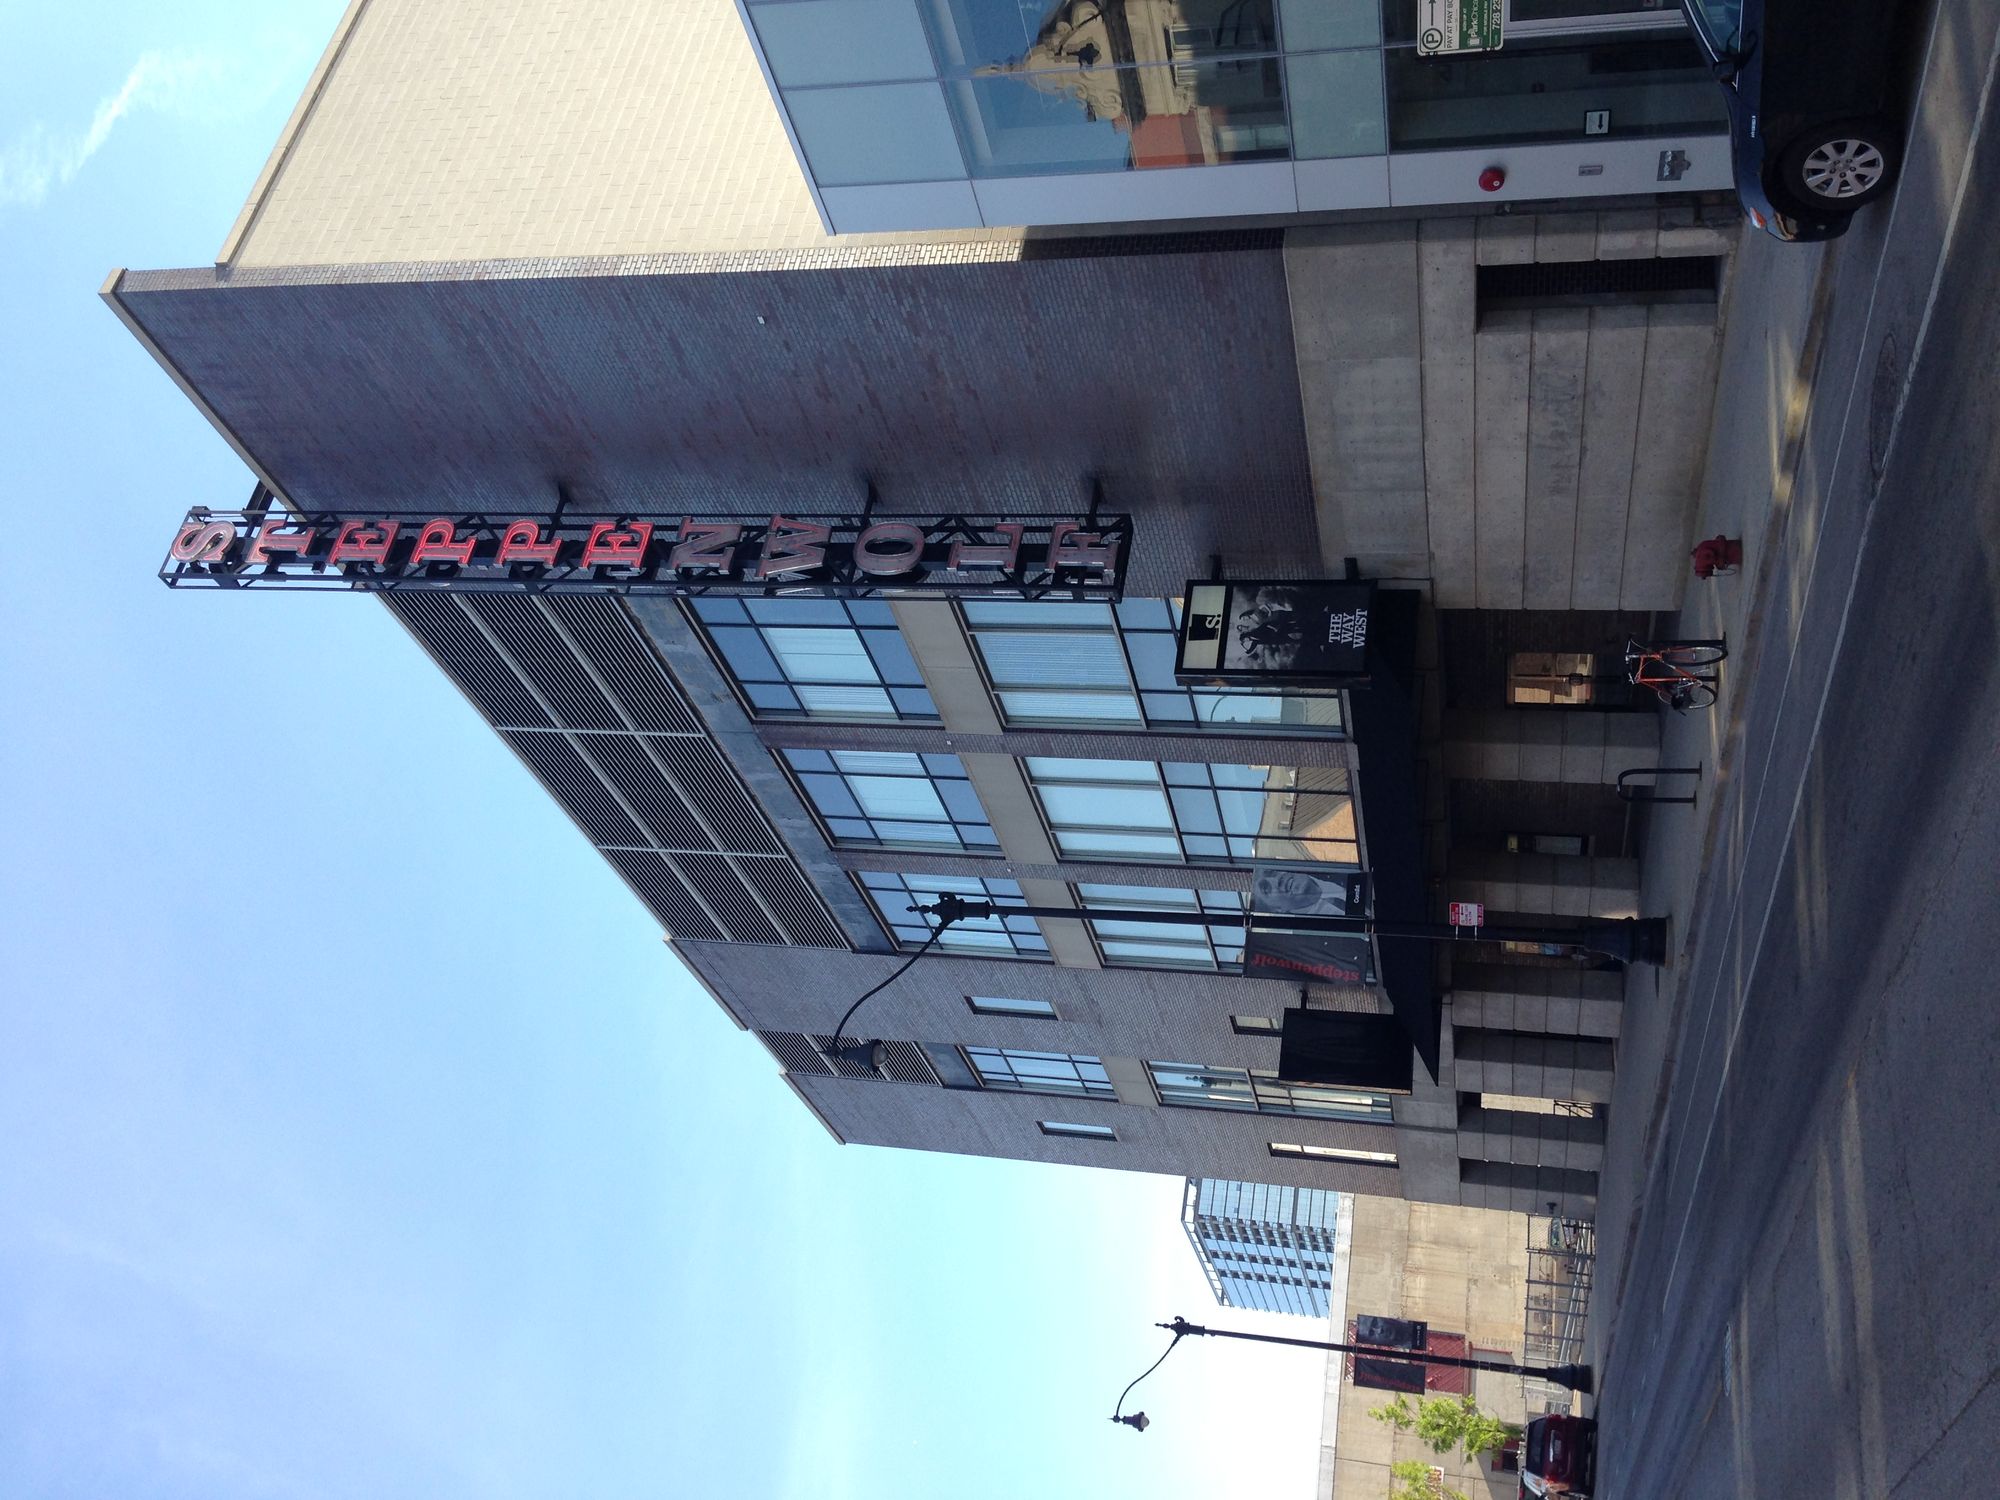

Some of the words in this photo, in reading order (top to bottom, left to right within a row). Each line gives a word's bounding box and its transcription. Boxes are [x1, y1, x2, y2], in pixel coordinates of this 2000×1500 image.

[1446, 25, 1453, 34] AT
[1491, 12, 1501, 30] 728
[170, 516, 1121, 579] STEPPENWOLF
[1328, 614, 1343, 642] THE
[1341, 612, 1355, 644] WAY
[1352, 608, 1368, 648] WEST
